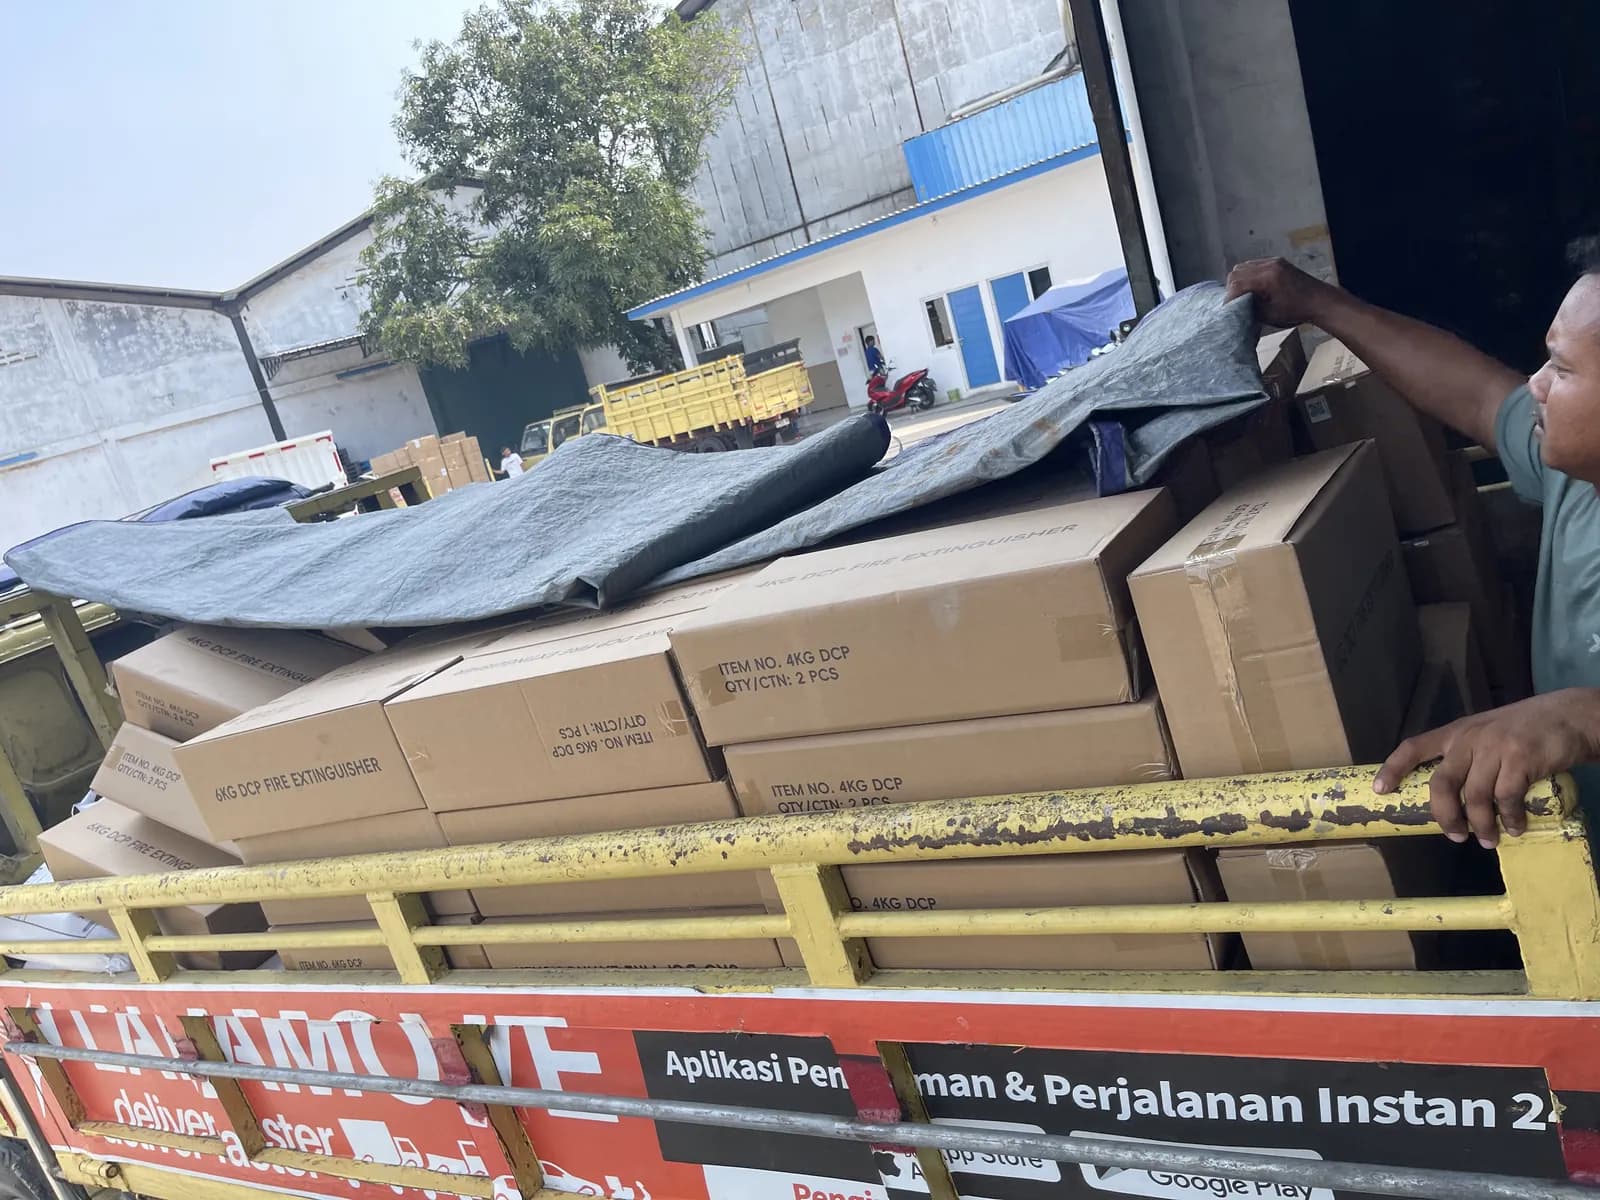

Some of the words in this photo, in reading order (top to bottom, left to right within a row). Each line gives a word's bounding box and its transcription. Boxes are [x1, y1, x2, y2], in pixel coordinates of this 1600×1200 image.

[848, 557, 898, 571] FIRE
[901, 523, 1079, 562] EXTINGUISHER
[187, 635, 211, 648] 4KG
[210, 644, 238, 656] DCP
[234, 653, 262, 667] FIRE
[718, 659, 752, 676] ITEM
[754, 656, 782, 671] NO.
[786, 651, 815, 667] 4KG
[819, 646, 850, 662] DCP
[724, 673, 793, 694] QTY/CTN:
[795, 671, 806, 685] 2
[808, 667, 840, 683] PCS
[558, 726, 582, 740] PCS
[584, 725, 590, 736] 1
[591, 714, 647, 733] QTY/CTN:
[576, 740, 598, 754] 6KG
[600, 736, 624, 750] NO.
[625, 731, 654, 746] ITEM
[552, 744, 574, 758] DCP
[117, 763, 147, 783] QTY/CTN:
[153, 779, 168, 791] PCS
[122, 752, 140, 766] ITEM
[152, 766, 166, 776] 4KG
[165, 770, 181, 782] DCP
[215, 785, 237, 802] 6KG
[237, 780, 261, 797] DCP
[263, 774, 291, 792] FIRE
[290, 757, 383, 787] EXTINGUISHER
[771, 784, 805, 797] ITEM
[807, 782, 835, 795] NO.
[840, 779, 868, 793] 4KG
[871, 777, 903, 792] DCP
[777, 799, 844, 814] QTY/CTN:
[107, 832, 130, 844] DCP
[127, 840, 152, 855] FIRE
[850, 897, 868, 909] O.
[872, 897, 902, 909] 4KG
[905, 897, 937, 910] DCP
[299, 961, 315, 970] ITEM
[348, 958, 364, 968] DCP
[666, 1050, 783, 1083] Aplikasi
[1006, 1071, 1037, 1103] &
[1043, 1074, 1304, 1123] Perjalanan
[1318, 1087, 1497, 1129] Instan
[1512, 1092, 1560, 1131] 2
[217, 1112, 335, 1179] aster
[1148, 1169, 1248, 1198] Google
[1255, 1181, 1313, 1199] Play
